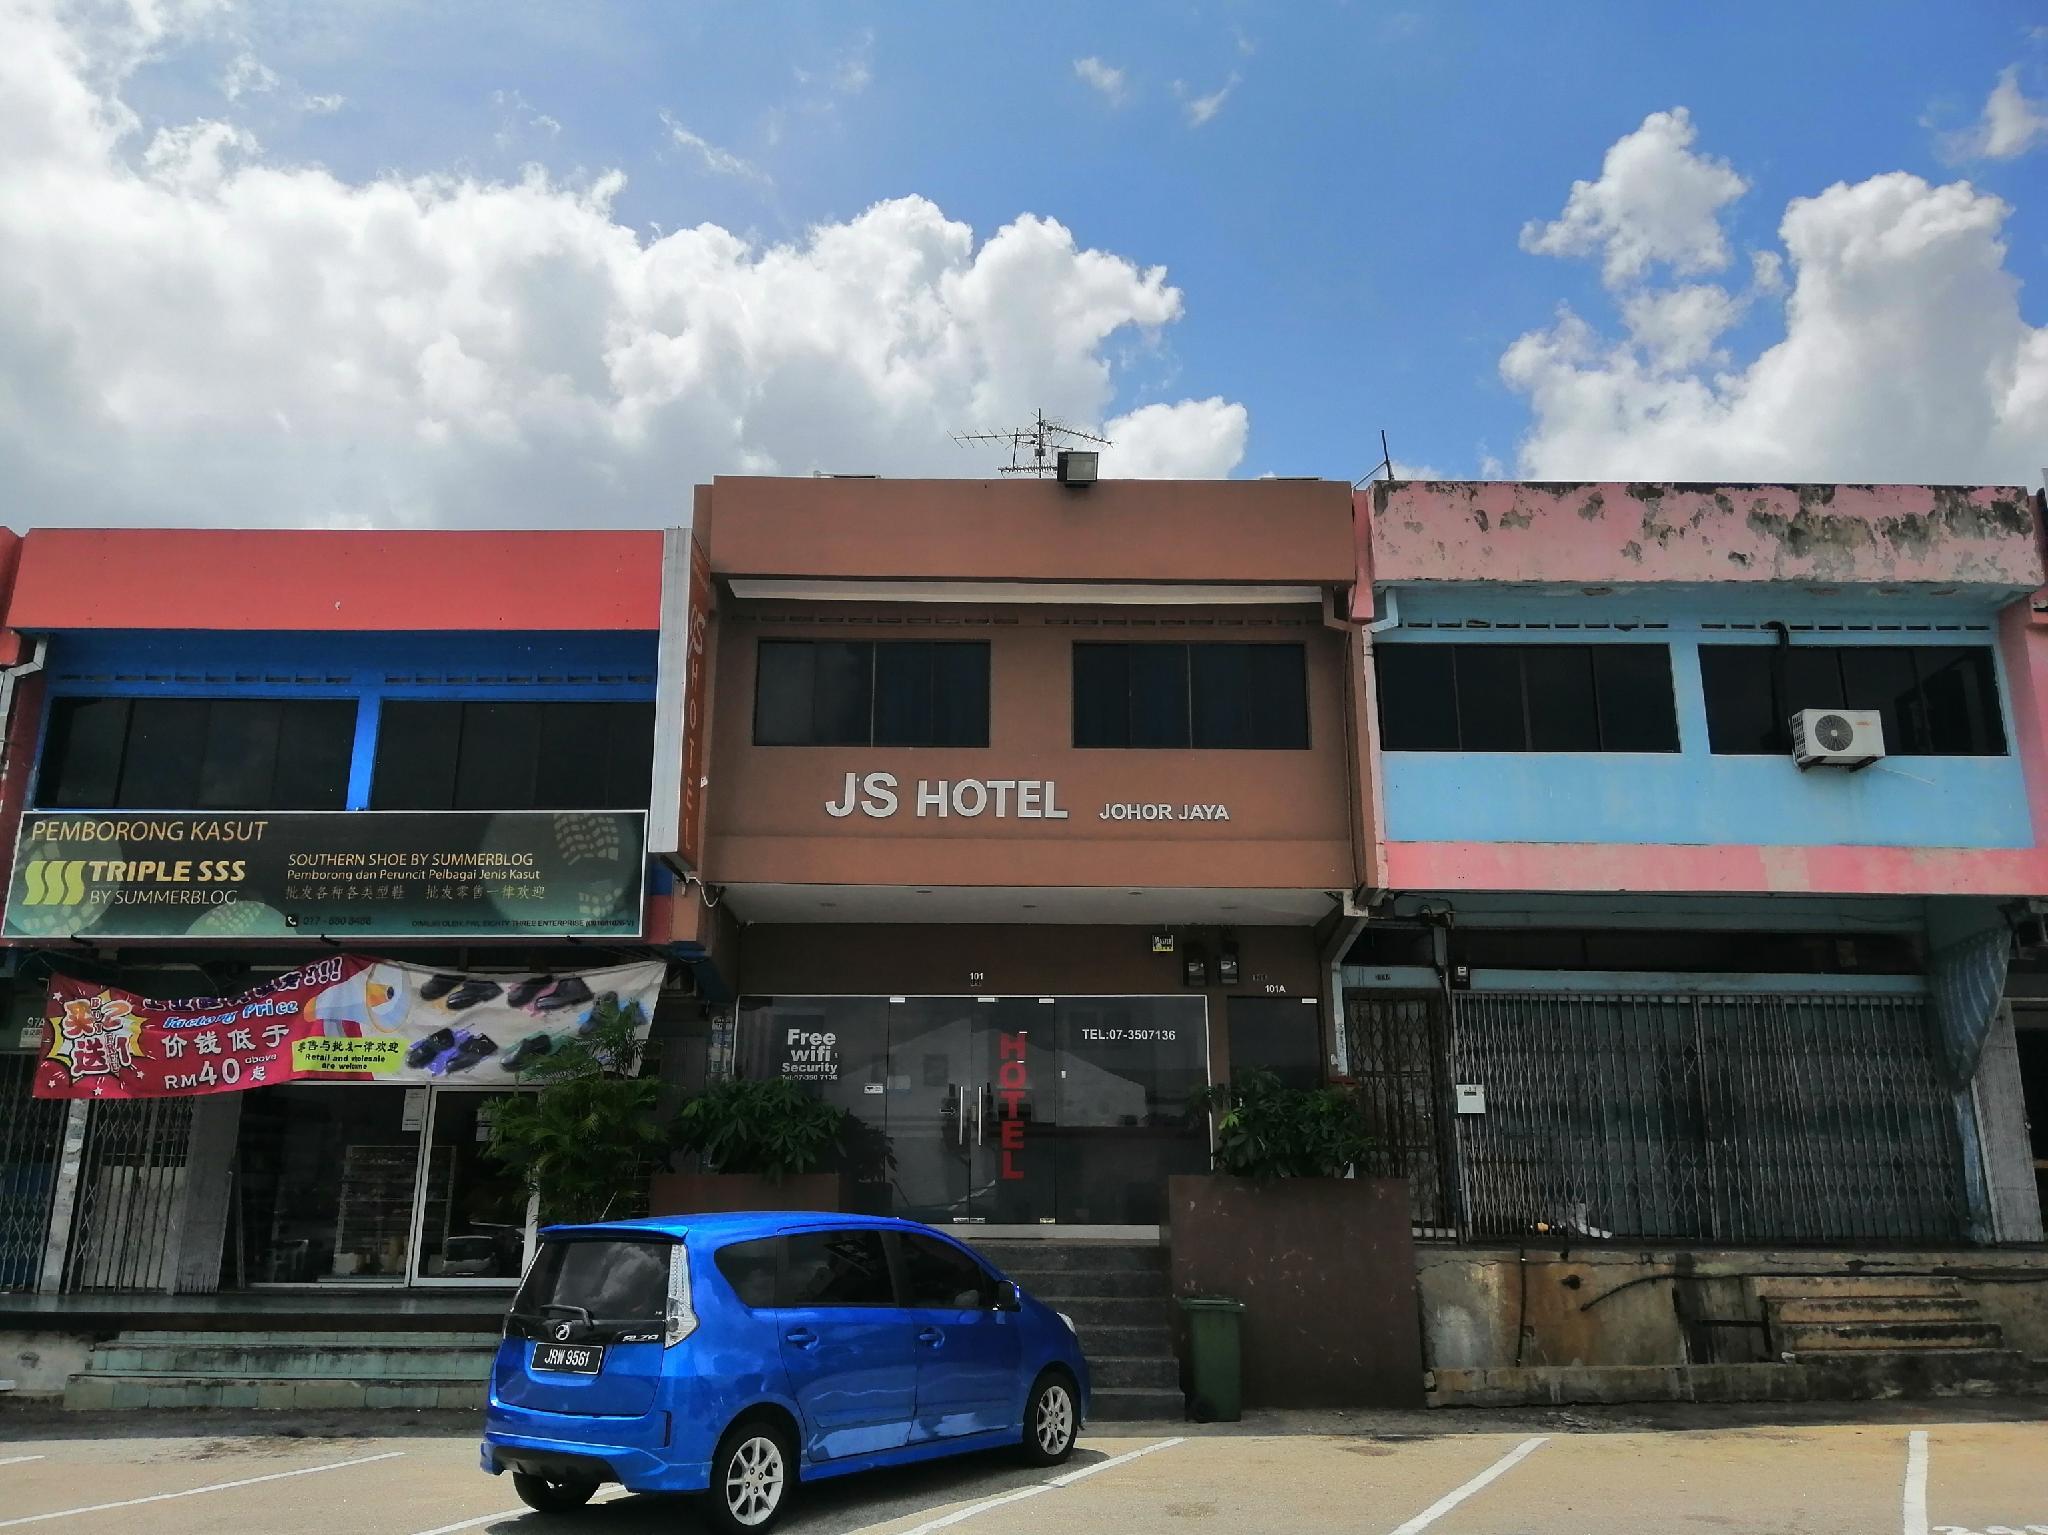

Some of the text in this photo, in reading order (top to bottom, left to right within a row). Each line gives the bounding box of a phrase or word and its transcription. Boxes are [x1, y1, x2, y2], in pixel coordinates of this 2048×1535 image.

[685, 660, 699, 850] HOTEL
[825, 772, 1230, 820] JS HOTEL JOHOR JAYA
[31, 821, 269, 842] PEMBORONG KASUT
[288, 853, 534, 867] SOUTHERN SHOE BY SUMMERBLOG
[89, 860, 247, 883] TRIPLE SSS
[287, 869, 541, 882] Pemborong dan Peruncit Pelbagai Jenis Kasut
[90, 889, 239, 905] BY SUMMERBLOG
[538, 919, 584, 927] ENTERPRISE
[970, 972, 984, 980] 101
[1265, 984, 1287, 993] 101A
[162, 1010, 239, 1029] Factory
[242, 999, 299, 1019] Price
[161, 1024, 290, 1058] 价钱低于
[787, 1028, 837, 1046] Free
[1082, 1029, 1176, 1041] TEL:07-3507136
[305, 1053, 330, 1061] Retail
[332, 1054, 349, 1062] and
[790, 1046, 831, 1062] wifi
[250, 1065, 267, 1081] 起
[321, 1062, 336, 1070] are
[781, 1062, 838, 1075] Security
[999, 1032, 1028, 1180] HOTEL
[544, 1348, 591, 1367] JRW 9561
